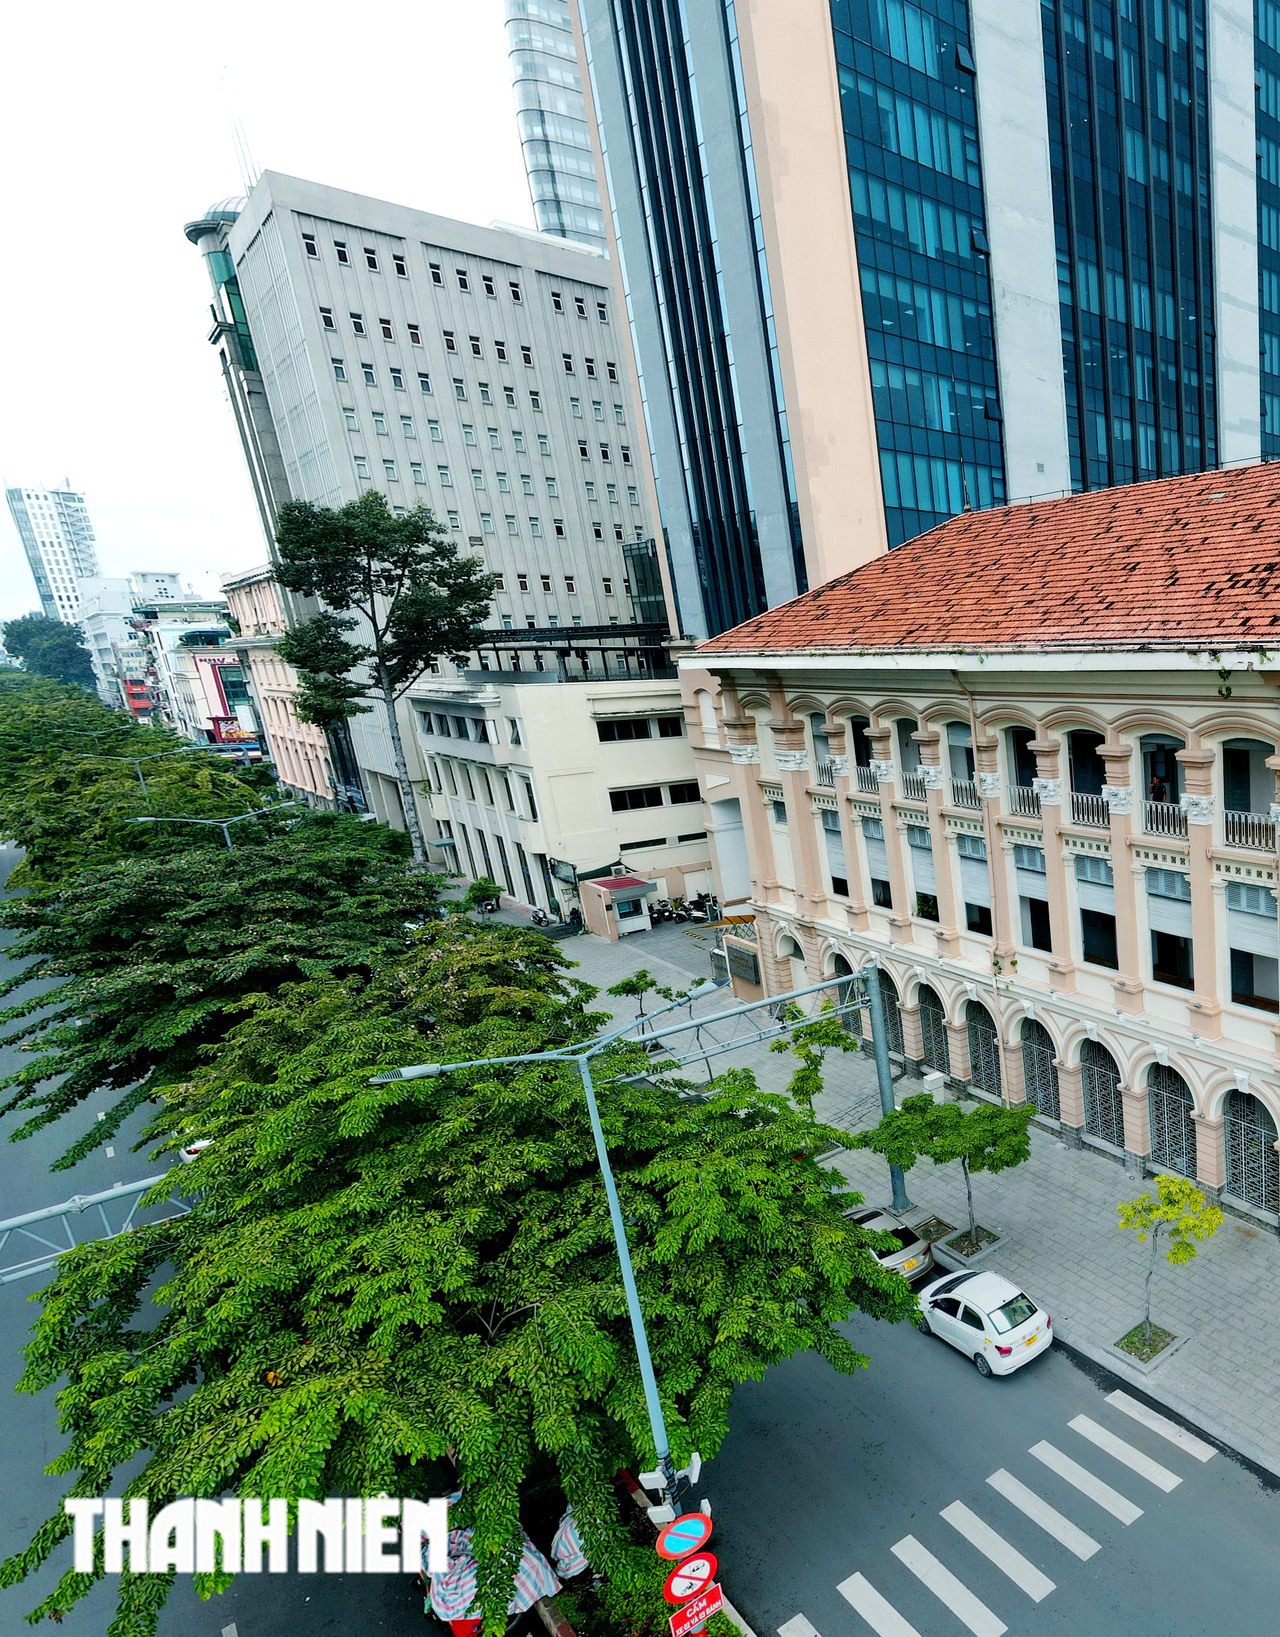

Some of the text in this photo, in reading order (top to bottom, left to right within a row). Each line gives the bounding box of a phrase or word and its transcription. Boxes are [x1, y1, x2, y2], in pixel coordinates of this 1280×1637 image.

[686, 1598, 707, 1618] CẤM
[690, 1615, 699, 1625] VÀ
[705, 1600, 721, 1615] BÁNH
